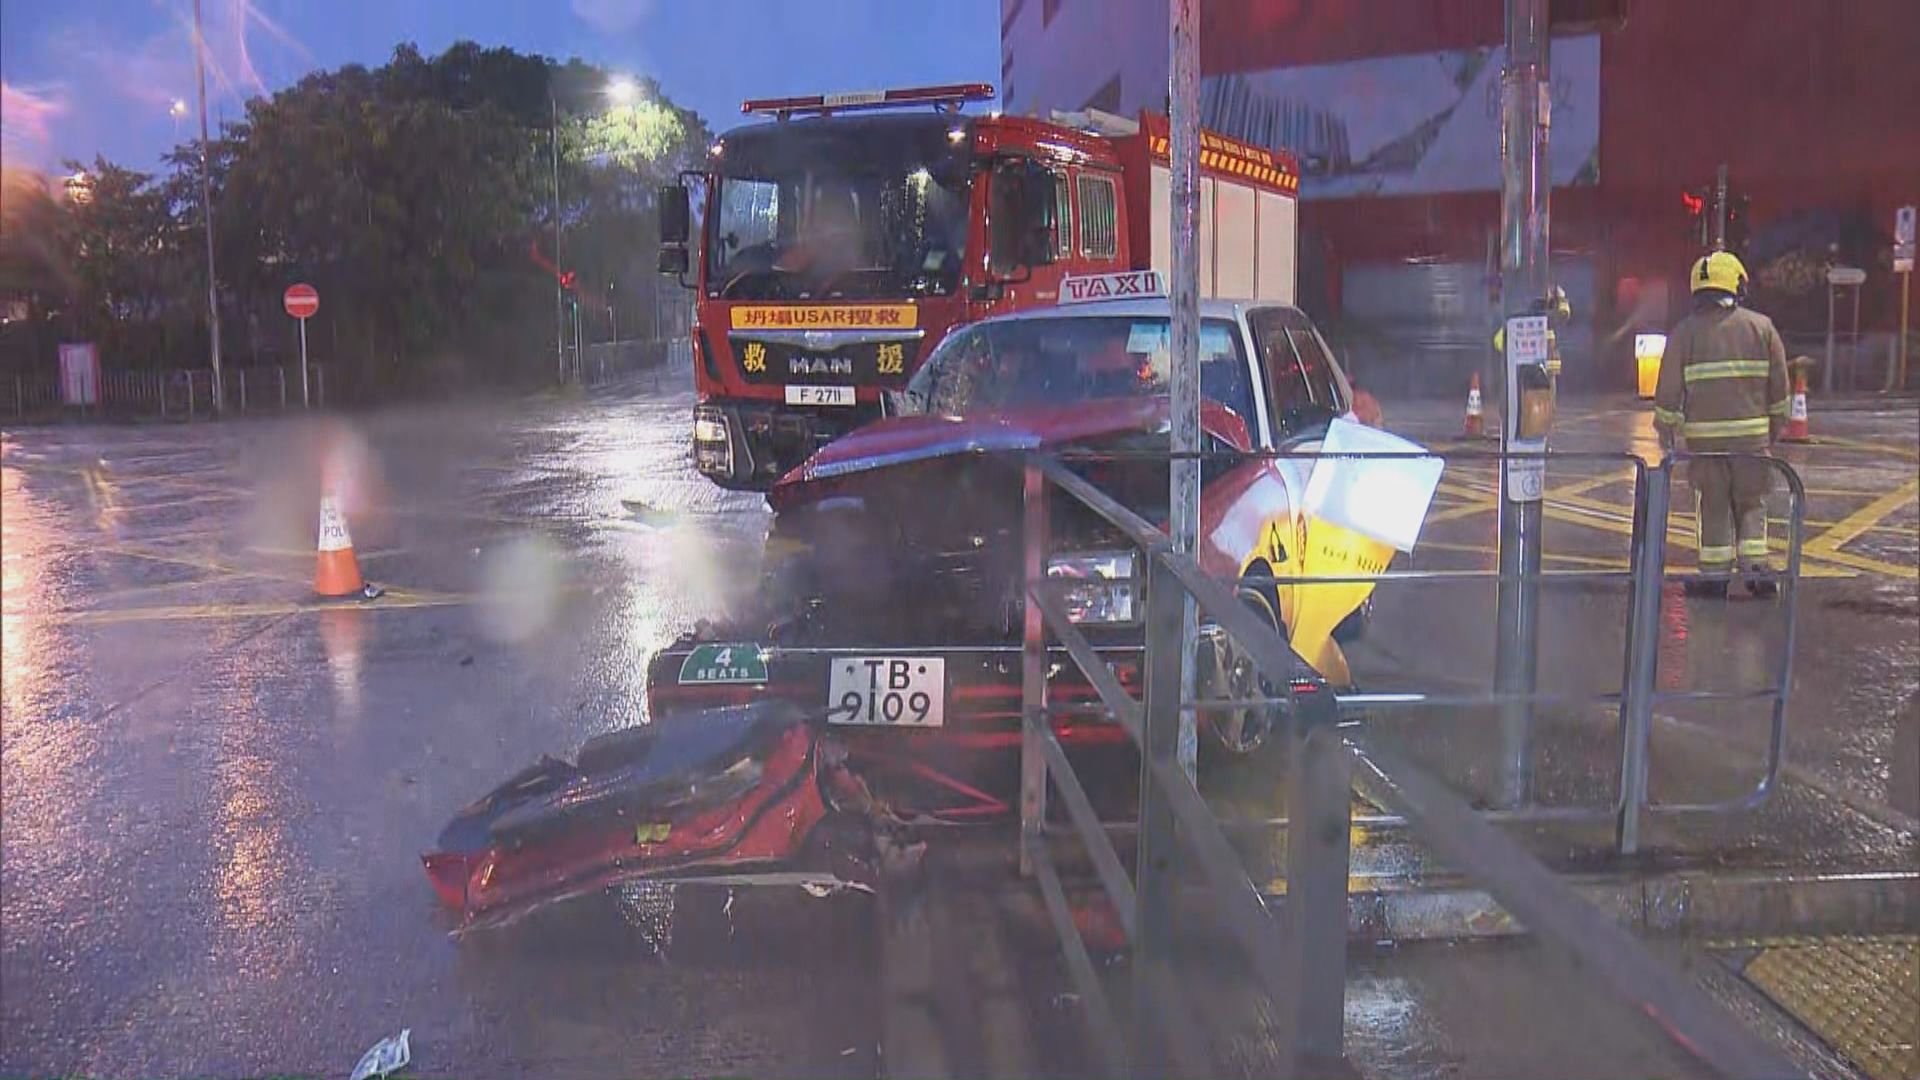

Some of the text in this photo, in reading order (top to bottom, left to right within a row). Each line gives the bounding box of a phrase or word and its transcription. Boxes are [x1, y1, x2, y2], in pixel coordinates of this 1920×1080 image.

[1065, 272, 1156, 299] TAXI
[743, 343, 904, 374] 救 援
[788, 357, 853, 375] MAN
[800, 389, 841, 403] F 2711
[715, 647, 732, 667] 4
[697, 667, 749, 679] SEATS
[863, 659, 911, 690] TB
[841, 691, 931, 723] 9109
